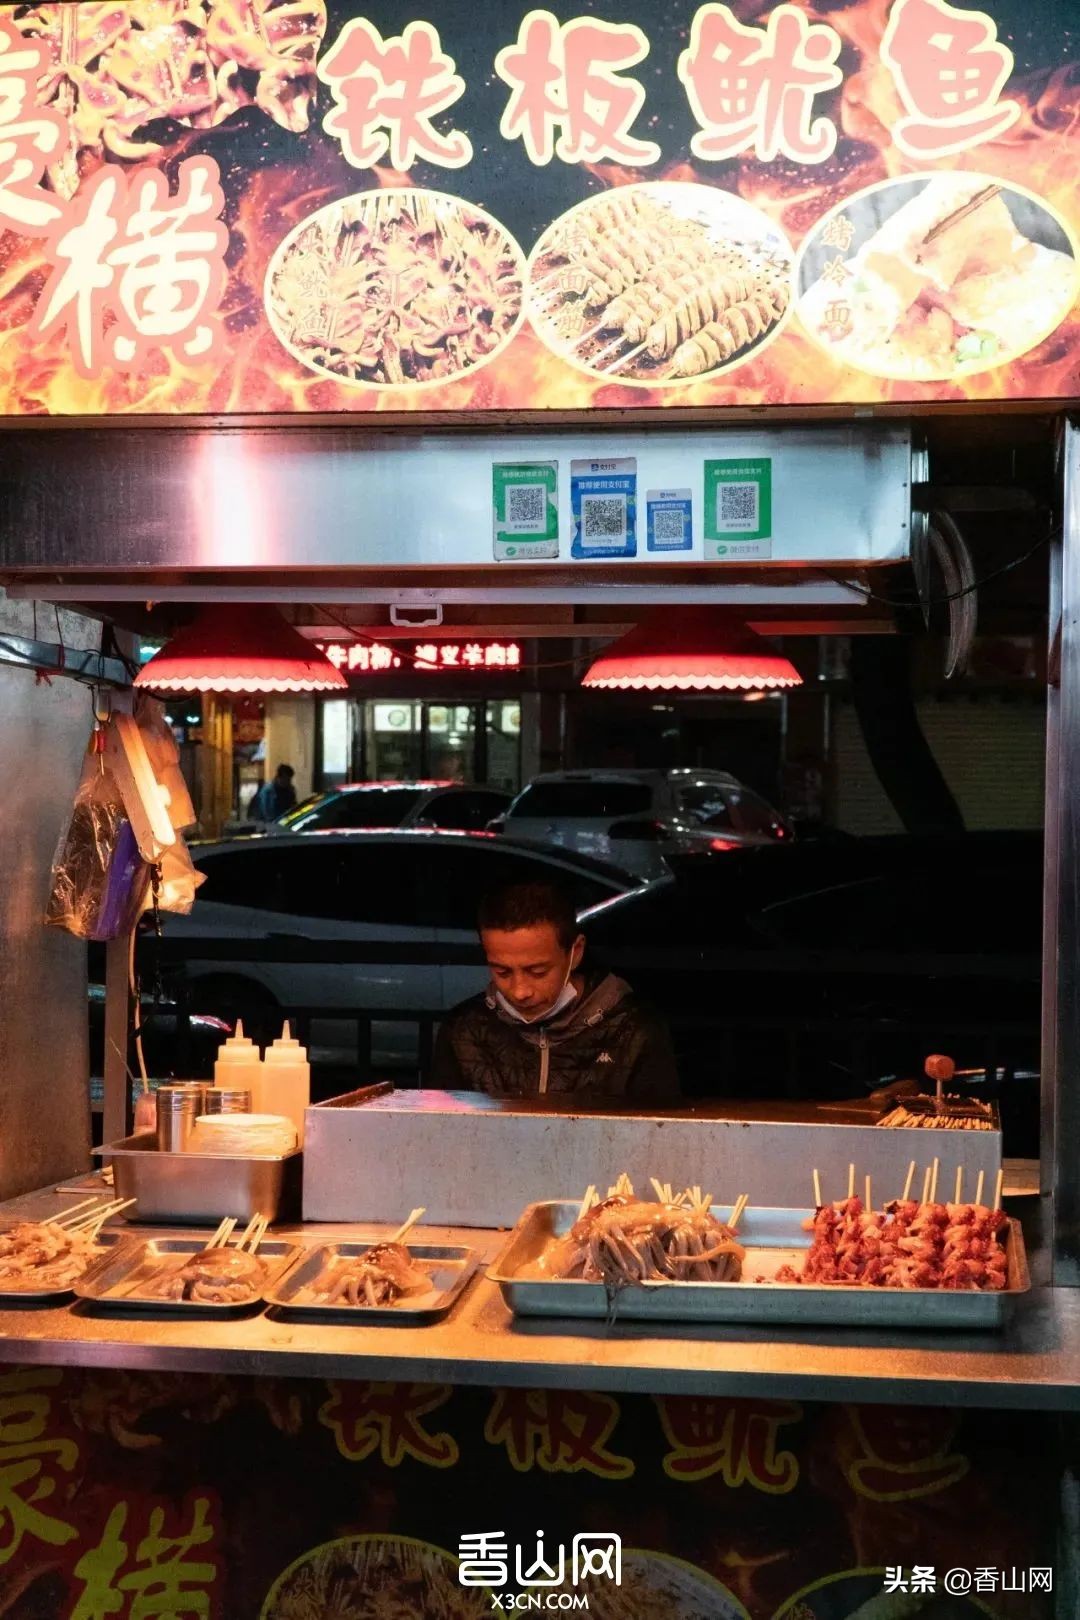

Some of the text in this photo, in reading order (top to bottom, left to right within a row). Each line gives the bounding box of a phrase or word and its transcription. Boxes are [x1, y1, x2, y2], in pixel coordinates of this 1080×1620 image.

[317, 0, 1022, 169] 铁板鱿鱼
[820, 214, 856, 326] 烤冷面
